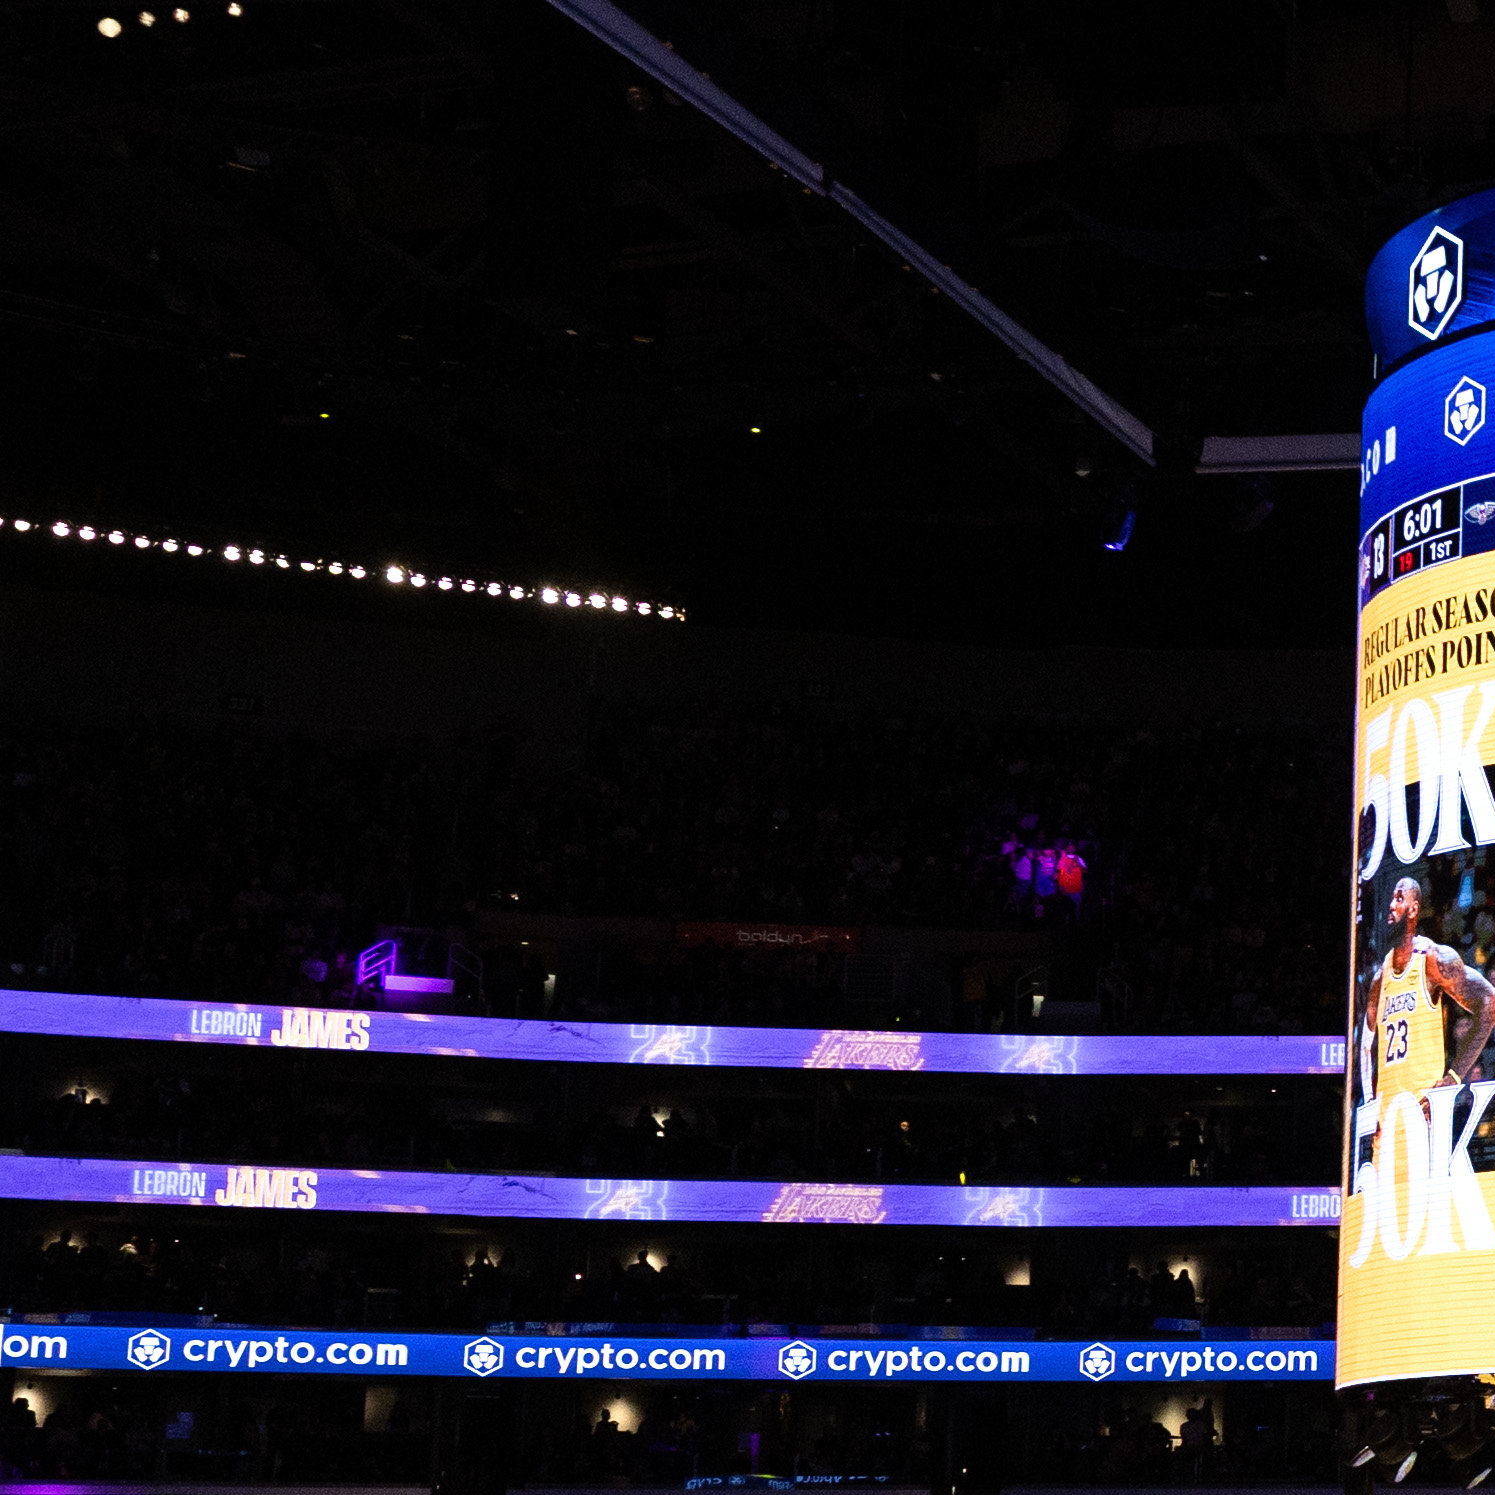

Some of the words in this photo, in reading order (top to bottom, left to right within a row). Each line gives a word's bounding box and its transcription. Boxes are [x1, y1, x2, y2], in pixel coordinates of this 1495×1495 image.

[1402, 500, 1444, 542] 6:01
[1373, 533, 1385, 579] 13
[1399, 551, 1414, 573] 19
[1429, 539, 1454, 562] 1ST
[1363, 605, 1428, 671] REGULAR
[1364, 644, 1437, 709] PLAYOFFS
[1381, 989, 1418, 1024] LAKERS
[190, 1009, 262, 1038] LEBRON
[270, 1007, 371, 1051] JAMES
[1385, 1017, 1409, 1066] 23
[133, 1168, 207, 1198] LEBRON
[214, 1165, 318, 1209] JAMES
[182, 1335, 409, 1371] crypto.com
[514, 1340, 726, 1375] crypto.com
[827, 1345, 1031, 1377] crypto.com
[1124, 1344, 1319, 1377] crypto.com
